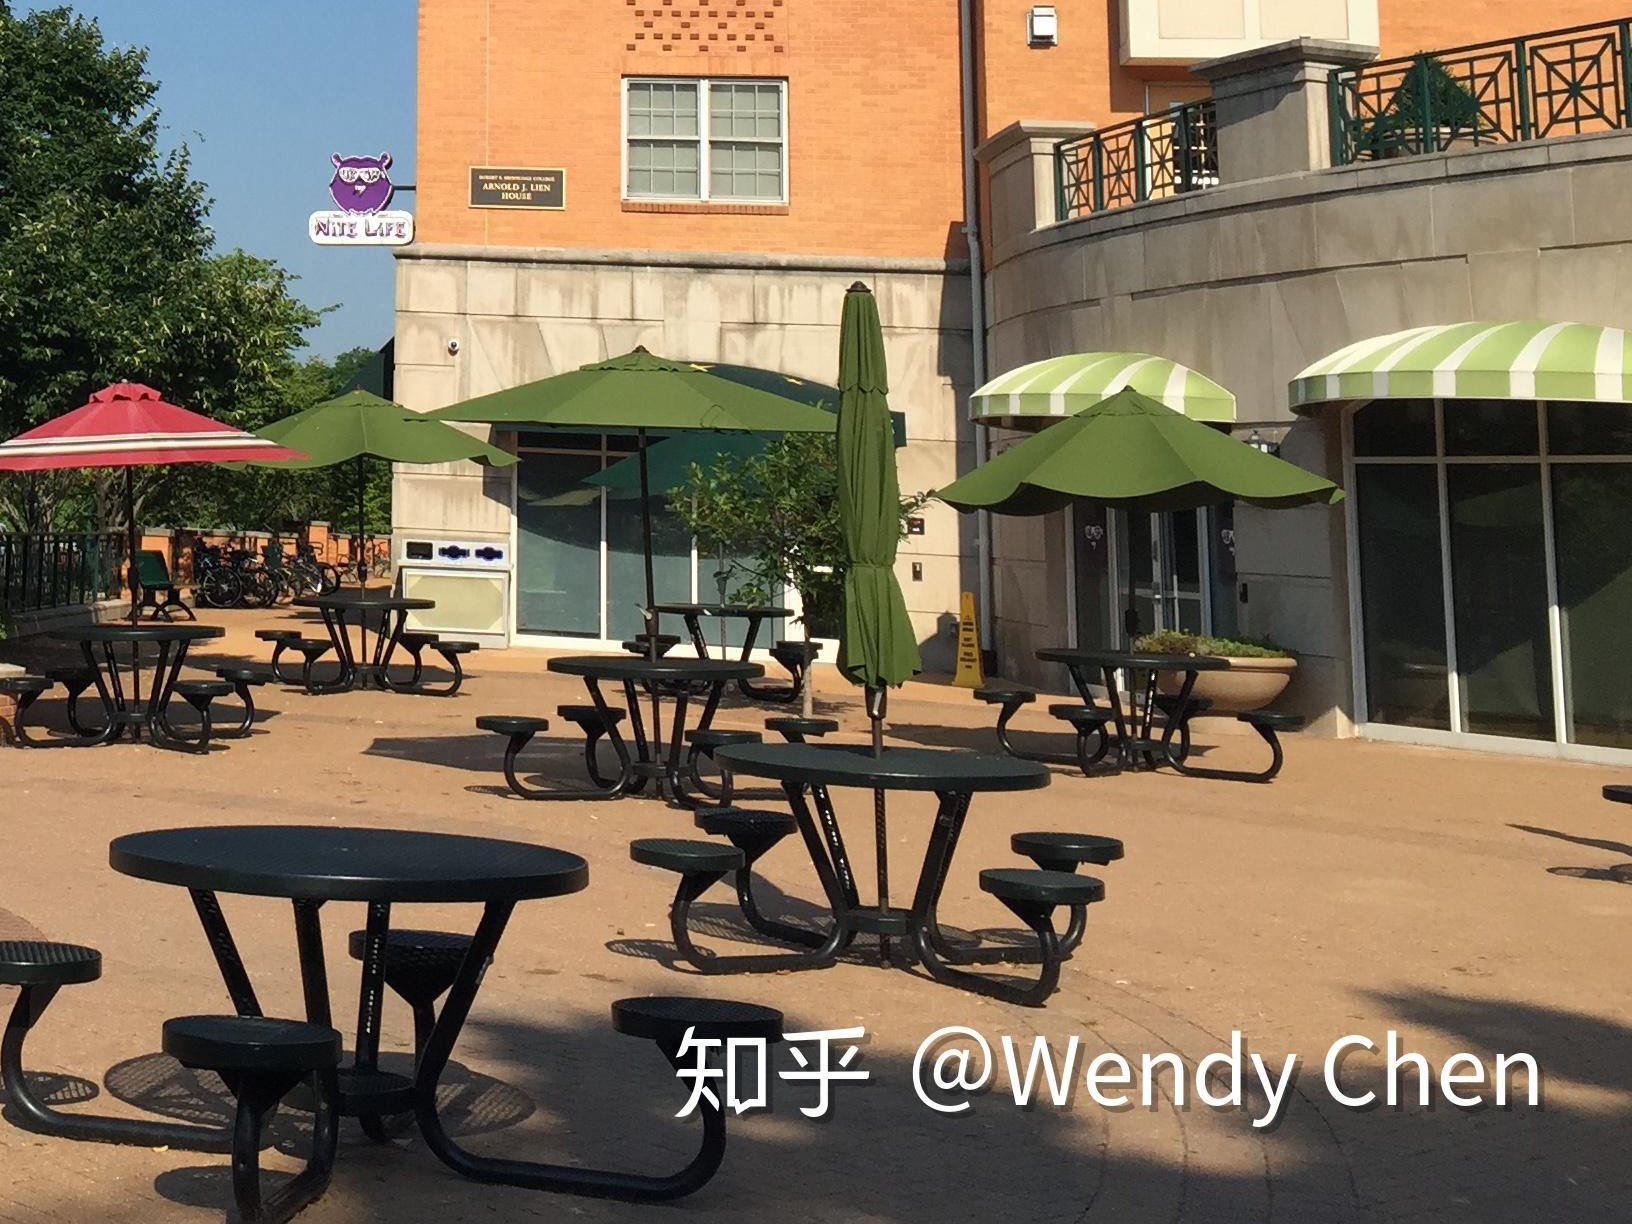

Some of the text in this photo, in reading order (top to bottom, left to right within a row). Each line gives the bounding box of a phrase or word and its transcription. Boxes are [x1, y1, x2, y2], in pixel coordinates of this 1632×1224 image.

[482, 182, 520, 191] ARNOLD
[530, 183, 551, 192] LIEN
[501, 192, 532, 201] HOUSE
